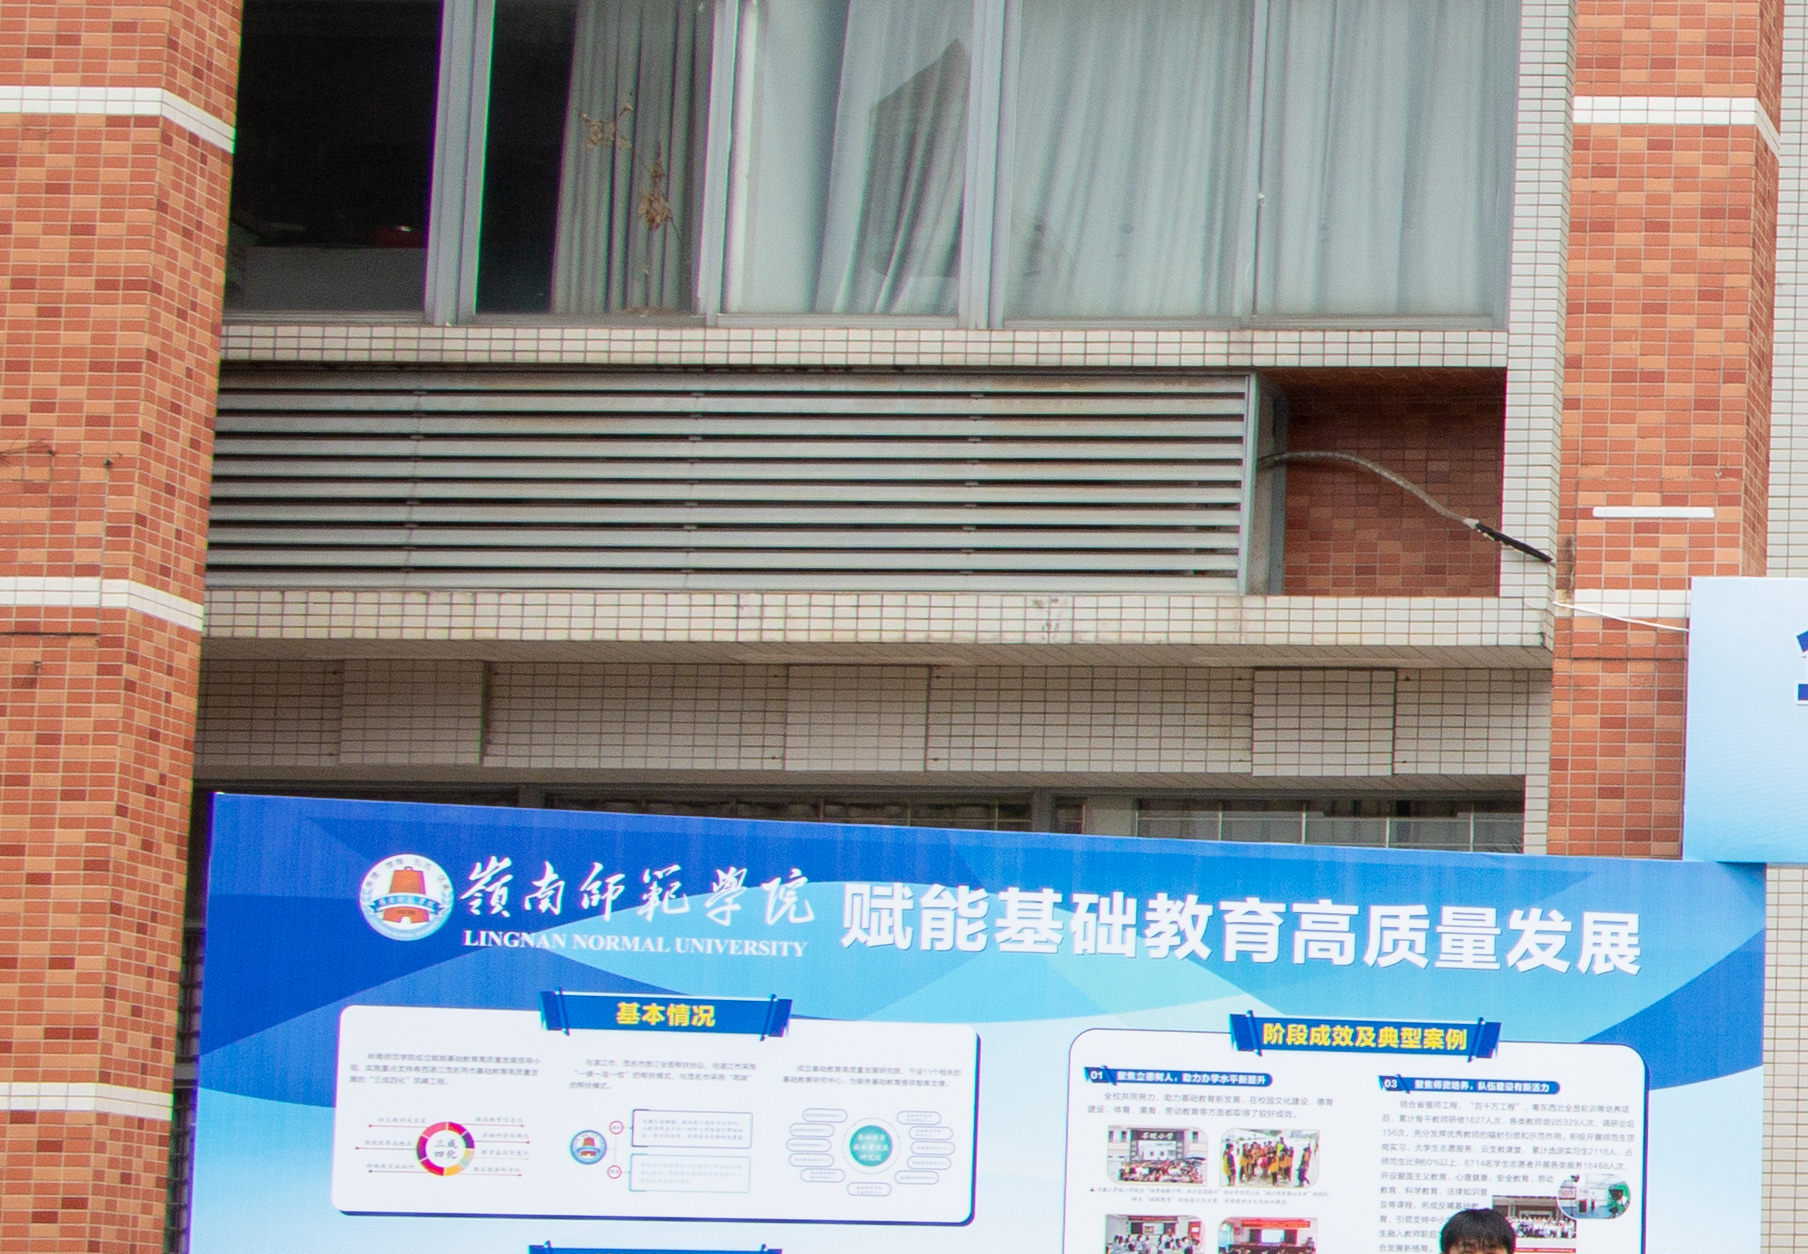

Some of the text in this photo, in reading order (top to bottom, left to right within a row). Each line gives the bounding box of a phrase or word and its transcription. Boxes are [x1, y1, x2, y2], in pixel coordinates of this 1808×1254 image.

[841, 882, 1641, 975] 赋能基础教育高质量发展
[463, 930, 809, 957] LINGNAN NORMAL UNIVERSITY
[616, 1001, 716, 1027] 基本情况
[1262, 1023, 1468, 1051] 阶段成效及典型案例
[1090, 1071, 1103, 1080] 01
[1384, 1080, 1398, 1088] 03
